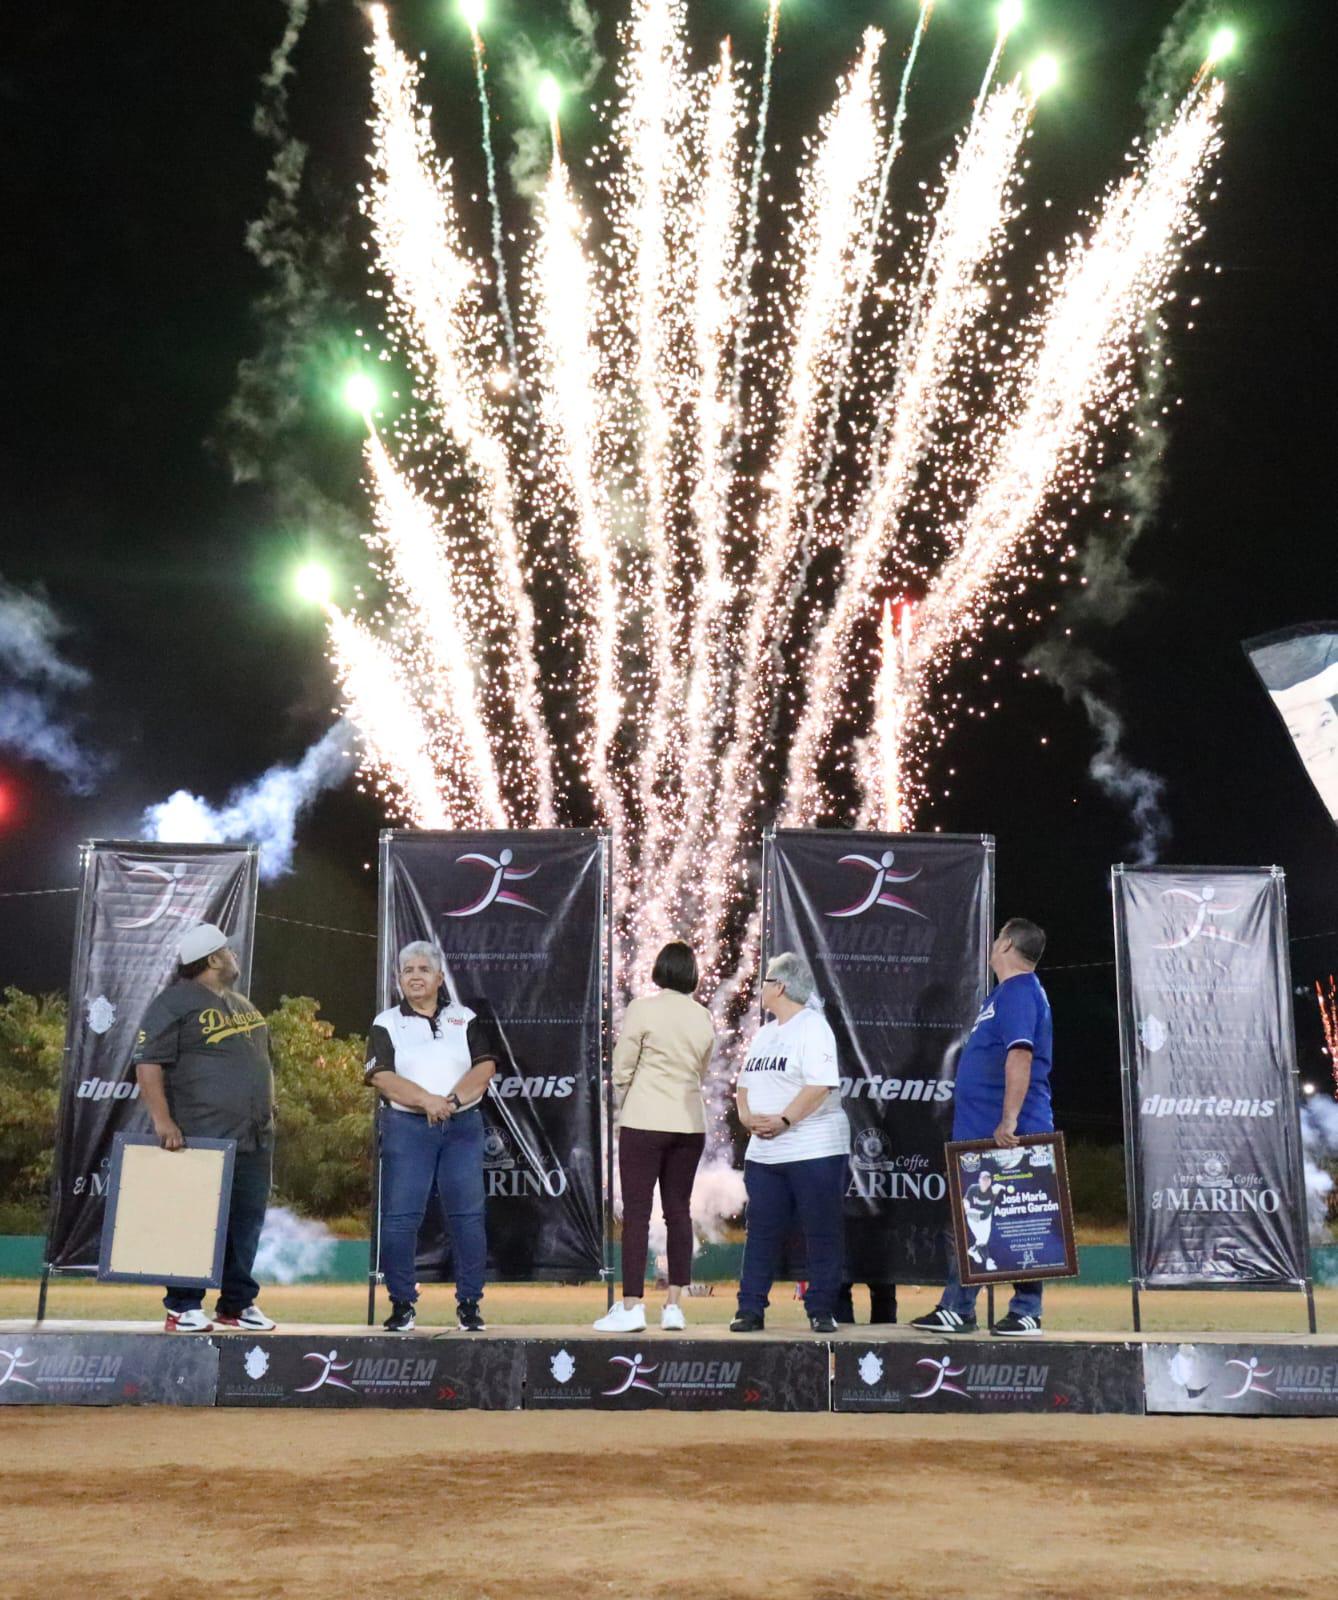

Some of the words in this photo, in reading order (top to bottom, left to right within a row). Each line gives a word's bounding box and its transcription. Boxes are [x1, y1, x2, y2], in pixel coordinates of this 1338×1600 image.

[1141, 1094, 1276, 1117] dportenis
[896, 1154, 929, 1171] Coffee
[1233, 1174, 1264, 1188] Coffee
[1001, 1192, 1021, 1205] José
[1166, 1188, 1280, 1214] MARINO
[993, 1204, 1027, 1218] Aguirre
[38, 1355, 123, 1377] IMDEM
[352, 1358, 437, 1380] IMDEM
[658, 1361, 742, 1383] IMDEM
[967, 1365, 1048, 1386] IMDEM
